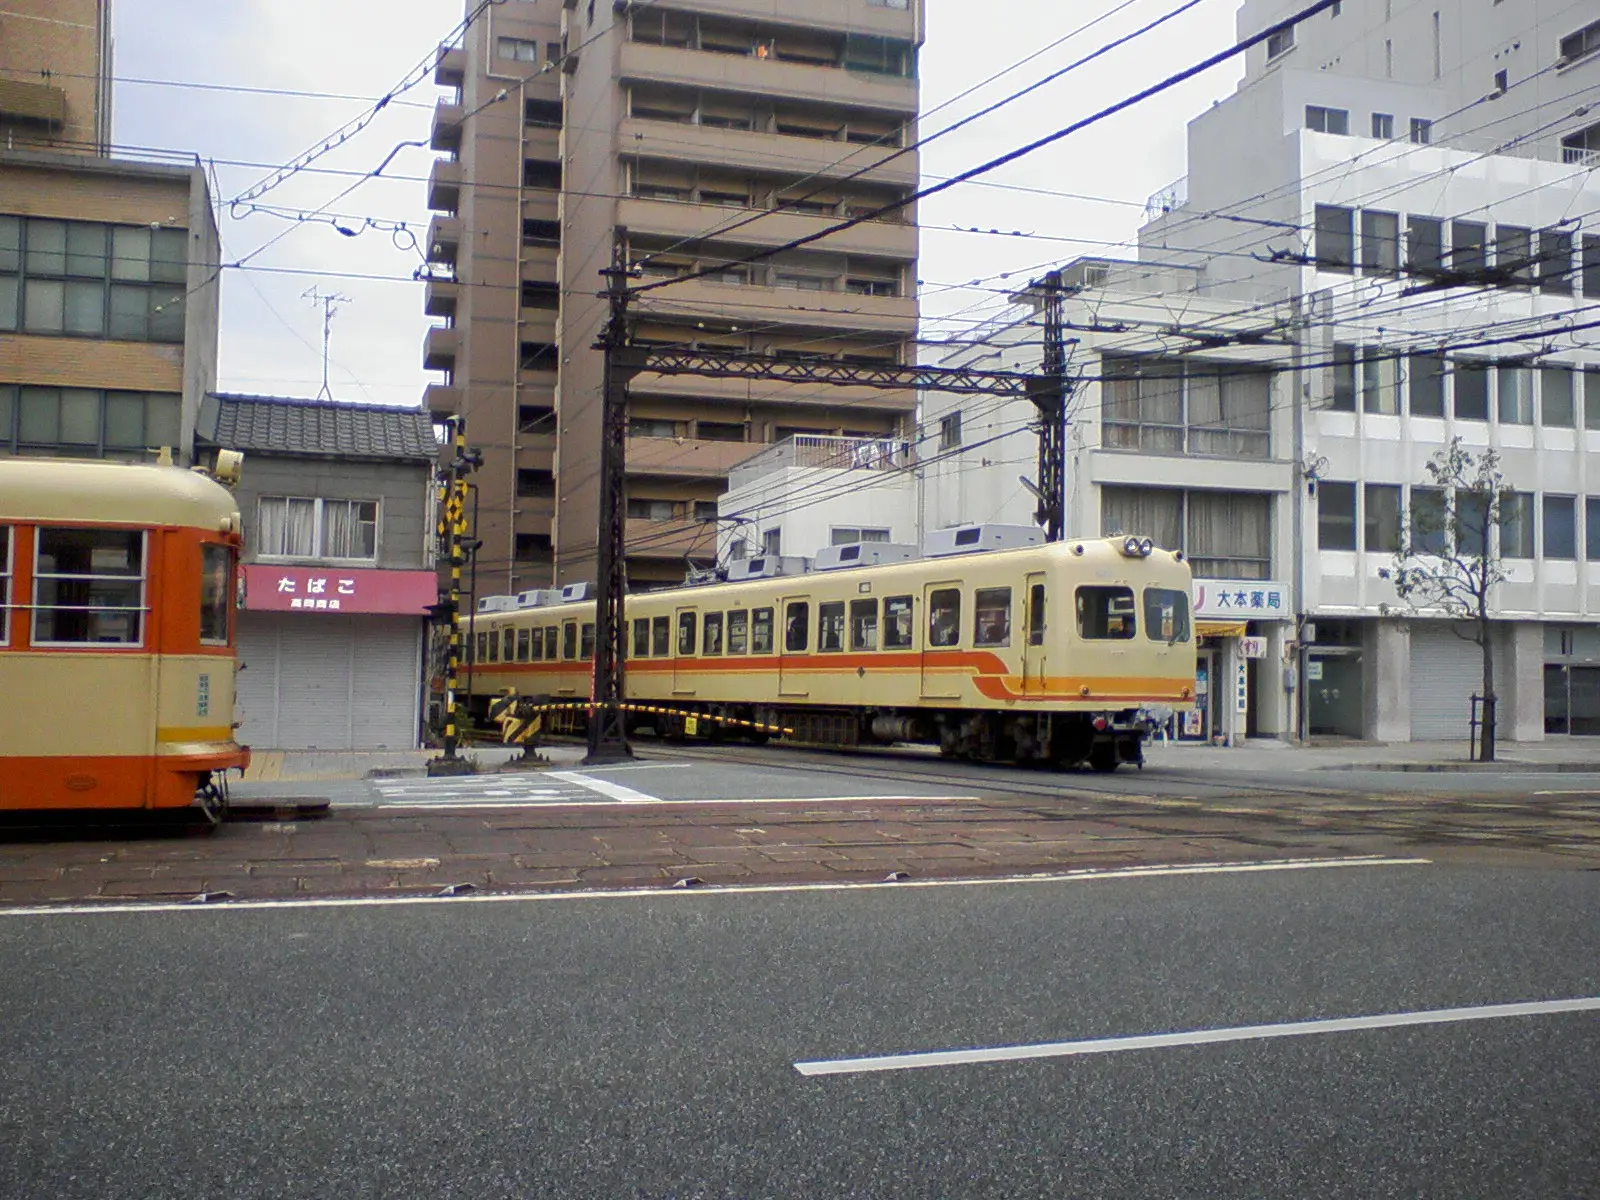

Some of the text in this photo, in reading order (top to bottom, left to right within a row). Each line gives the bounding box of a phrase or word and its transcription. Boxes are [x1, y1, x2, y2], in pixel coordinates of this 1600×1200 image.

[278, 577, 354, 594] たばこ
[1217, 589, 1280, 608] 大本薬局
